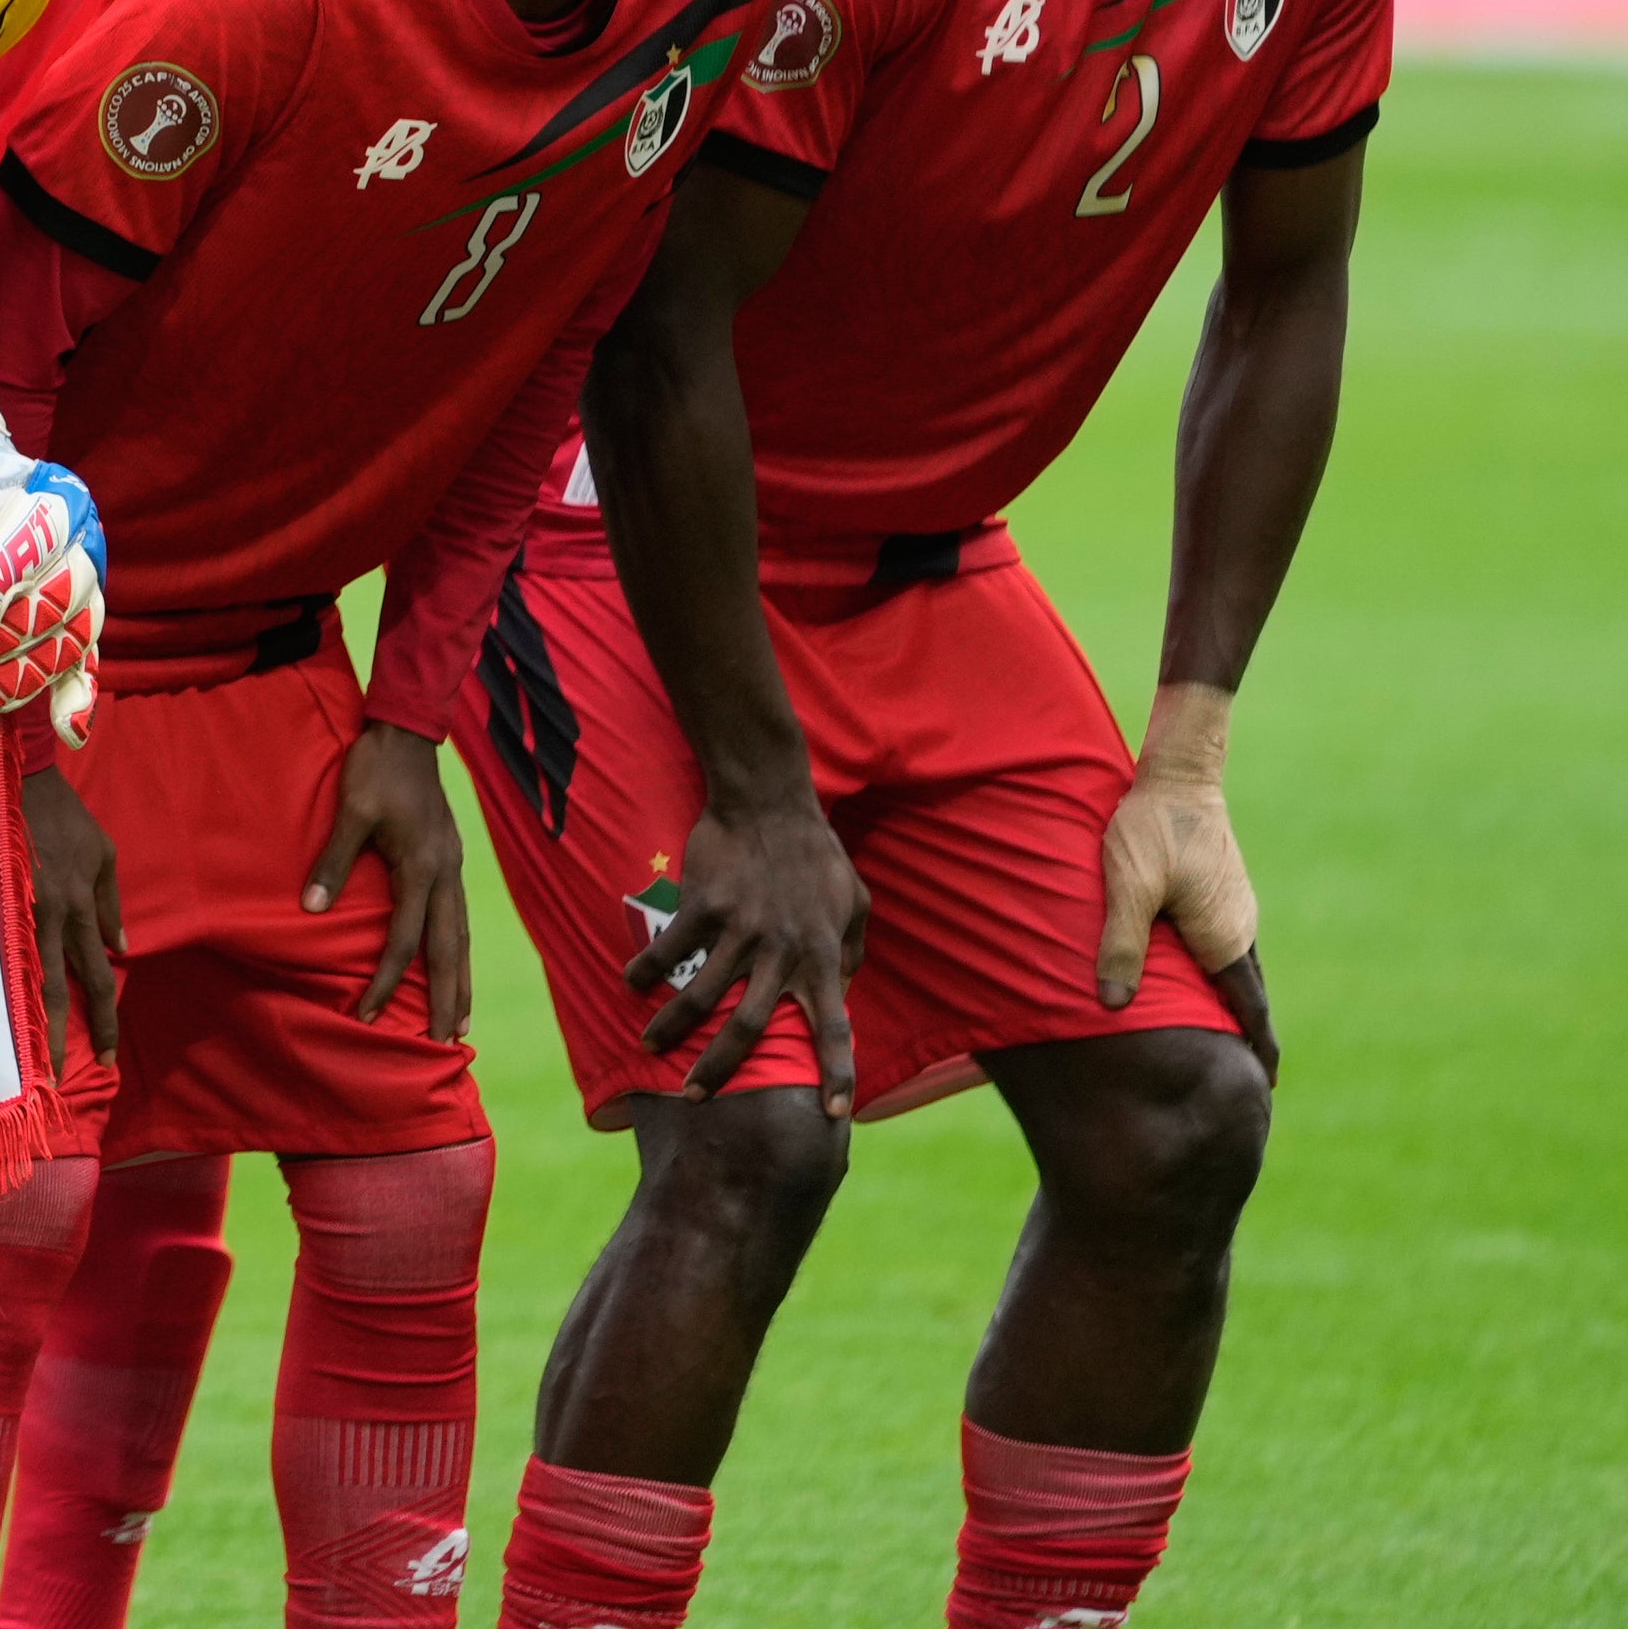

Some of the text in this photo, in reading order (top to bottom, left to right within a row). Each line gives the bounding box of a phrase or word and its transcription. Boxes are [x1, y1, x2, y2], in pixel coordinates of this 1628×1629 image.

[131, 71, 167, 87] CAF
[107, 81, 132, 159] MOROCCO 25
[353, 118, 438, 190] AB
[1074, 55, 1161, 217] 2
[129, 155, 182, 172] NATIONS
[418, 192, 541, 326] 8
